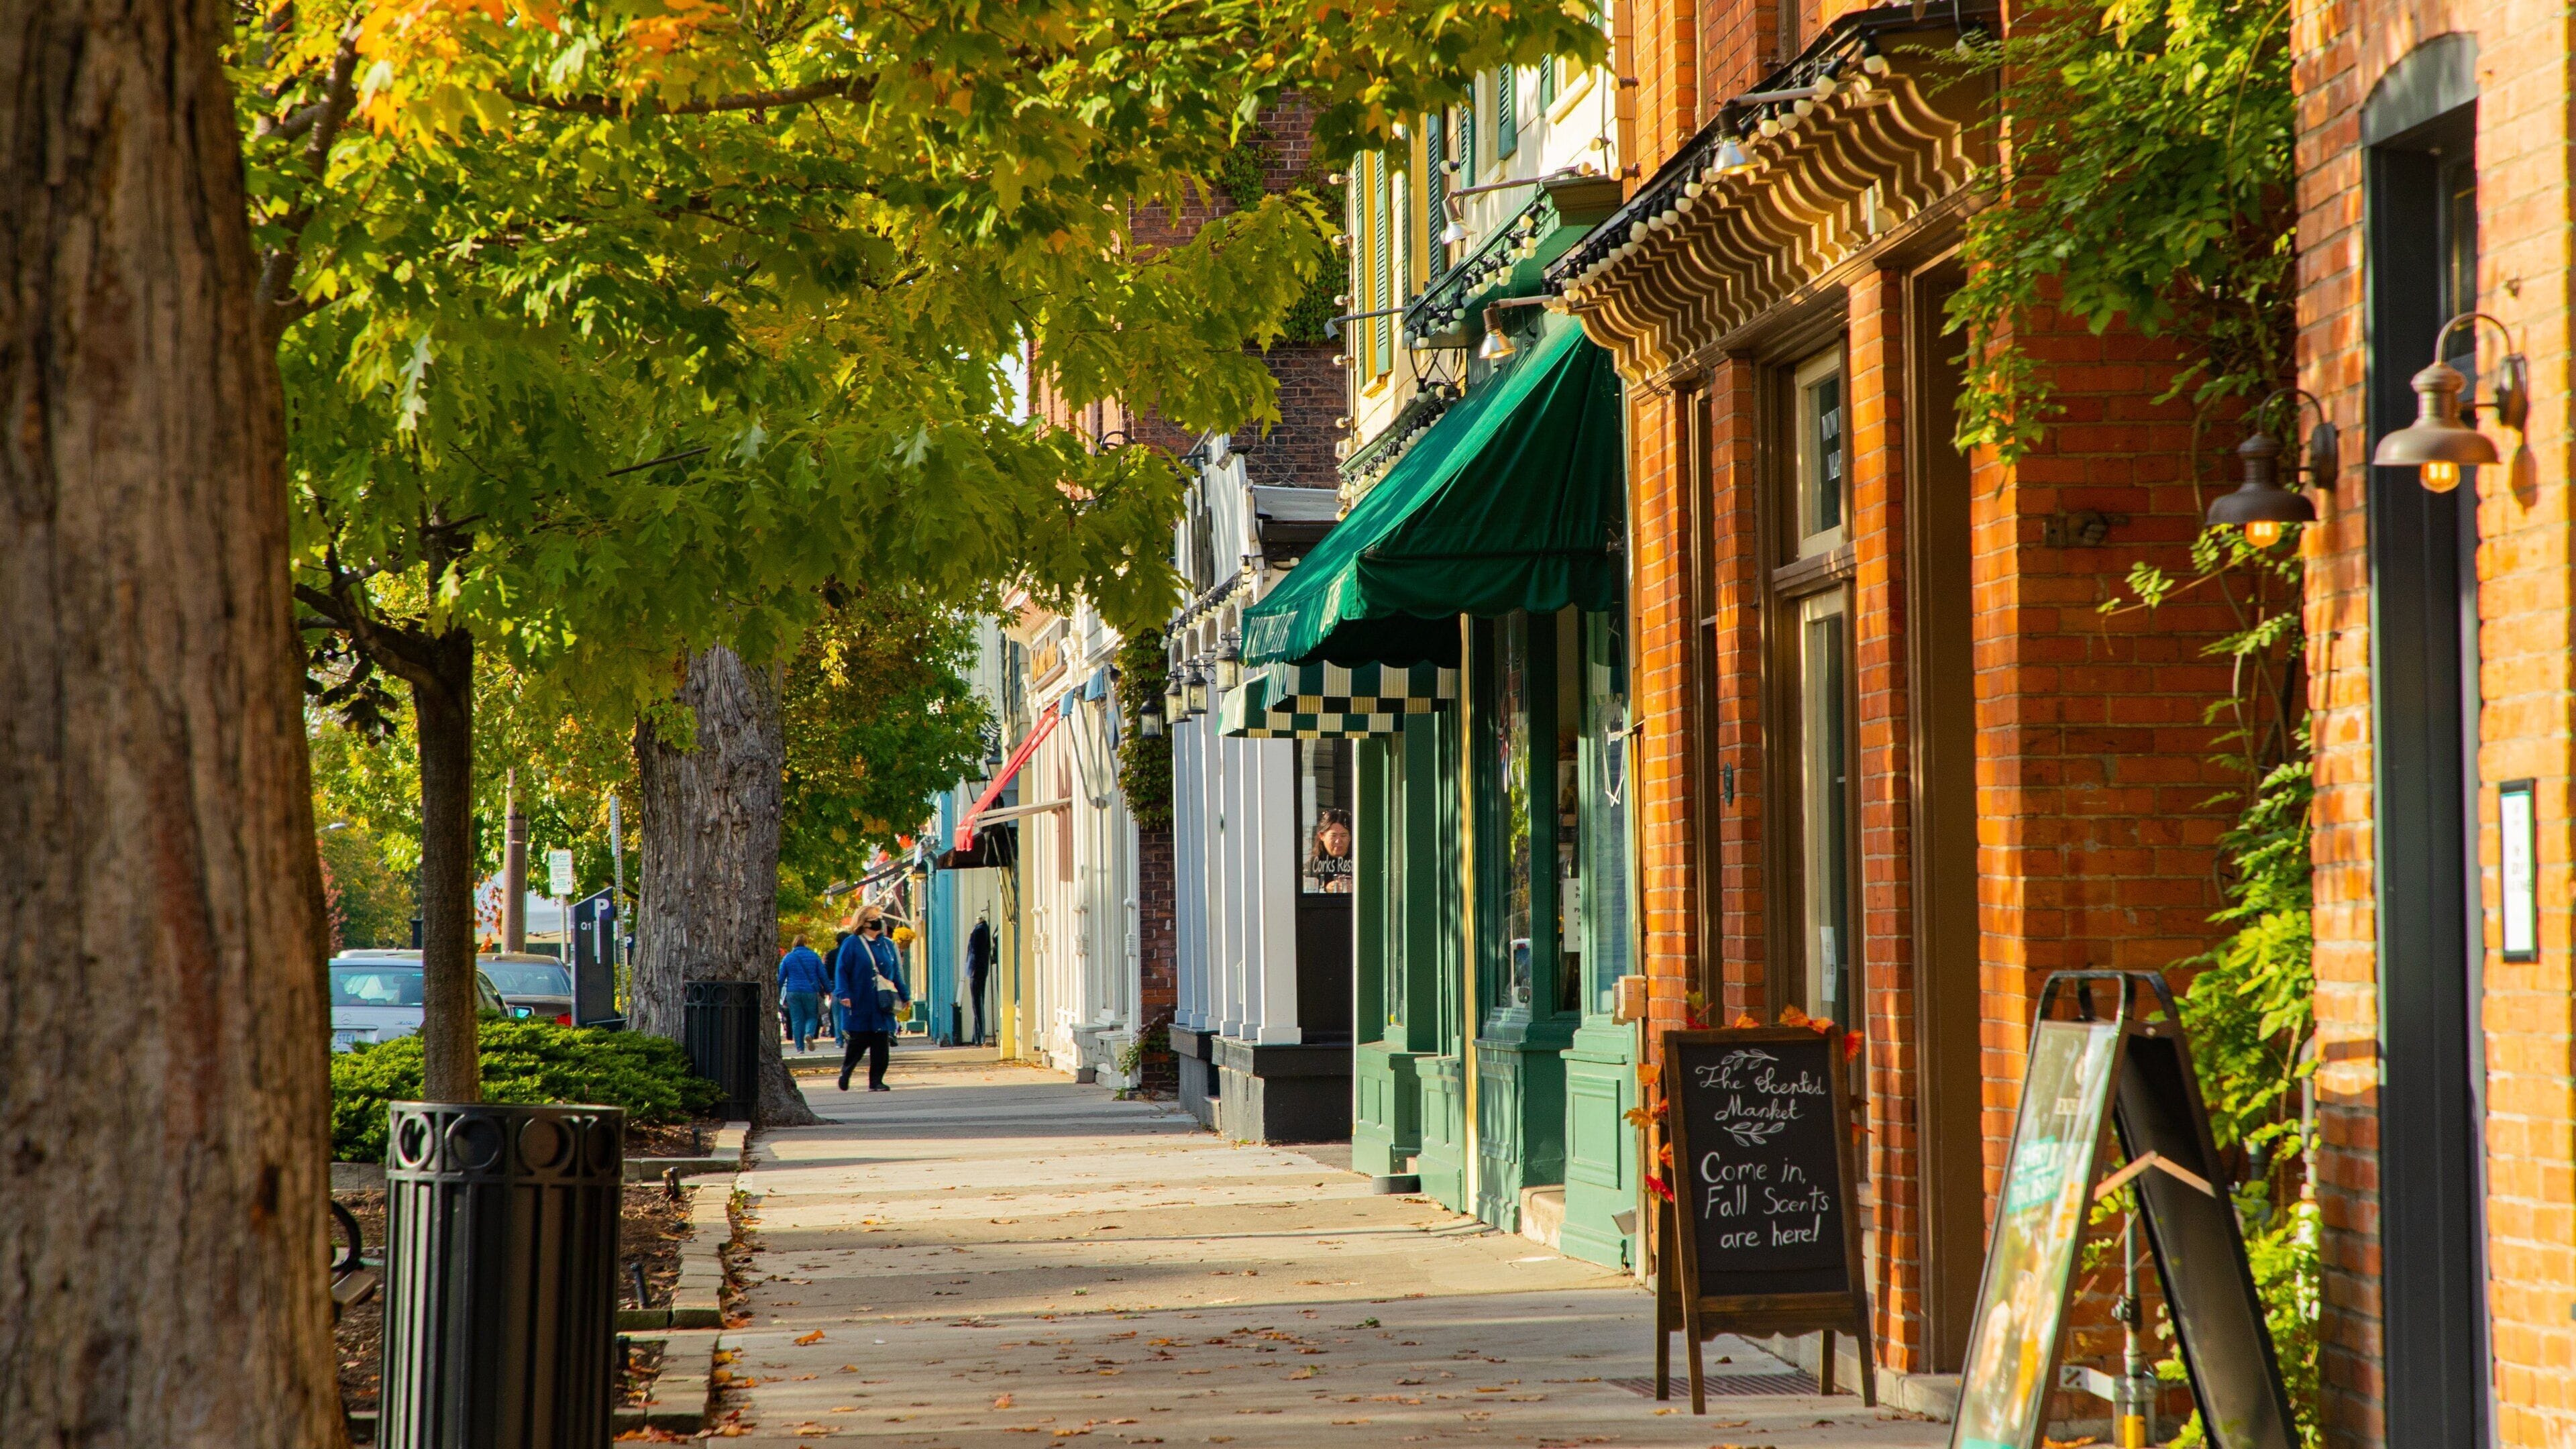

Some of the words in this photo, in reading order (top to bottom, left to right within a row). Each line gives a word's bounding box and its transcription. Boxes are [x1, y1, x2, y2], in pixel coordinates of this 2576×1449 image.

[1312, 855, 1336, 873] Corks
[594, 898, 610, 917] P
[580, 922, 592, 930] Q1
[624, 936, 633, 947] P
[1695, 1065, 1744, 1089] The
[1754, 1067, 1826, 1095] Scented
[1714, 1094, 1805, 1121] Market
[1701, 1152, 1768, 1183] Come
[1780, 1157, 1806, 1184] in,
[1705, 1184, 1747, 1219] Fall
[1763, 1185, 1830, 1214] Scents
[1721, 1232, 1760, 1248] are
[1772, 1214, 1821, 1246] here!
